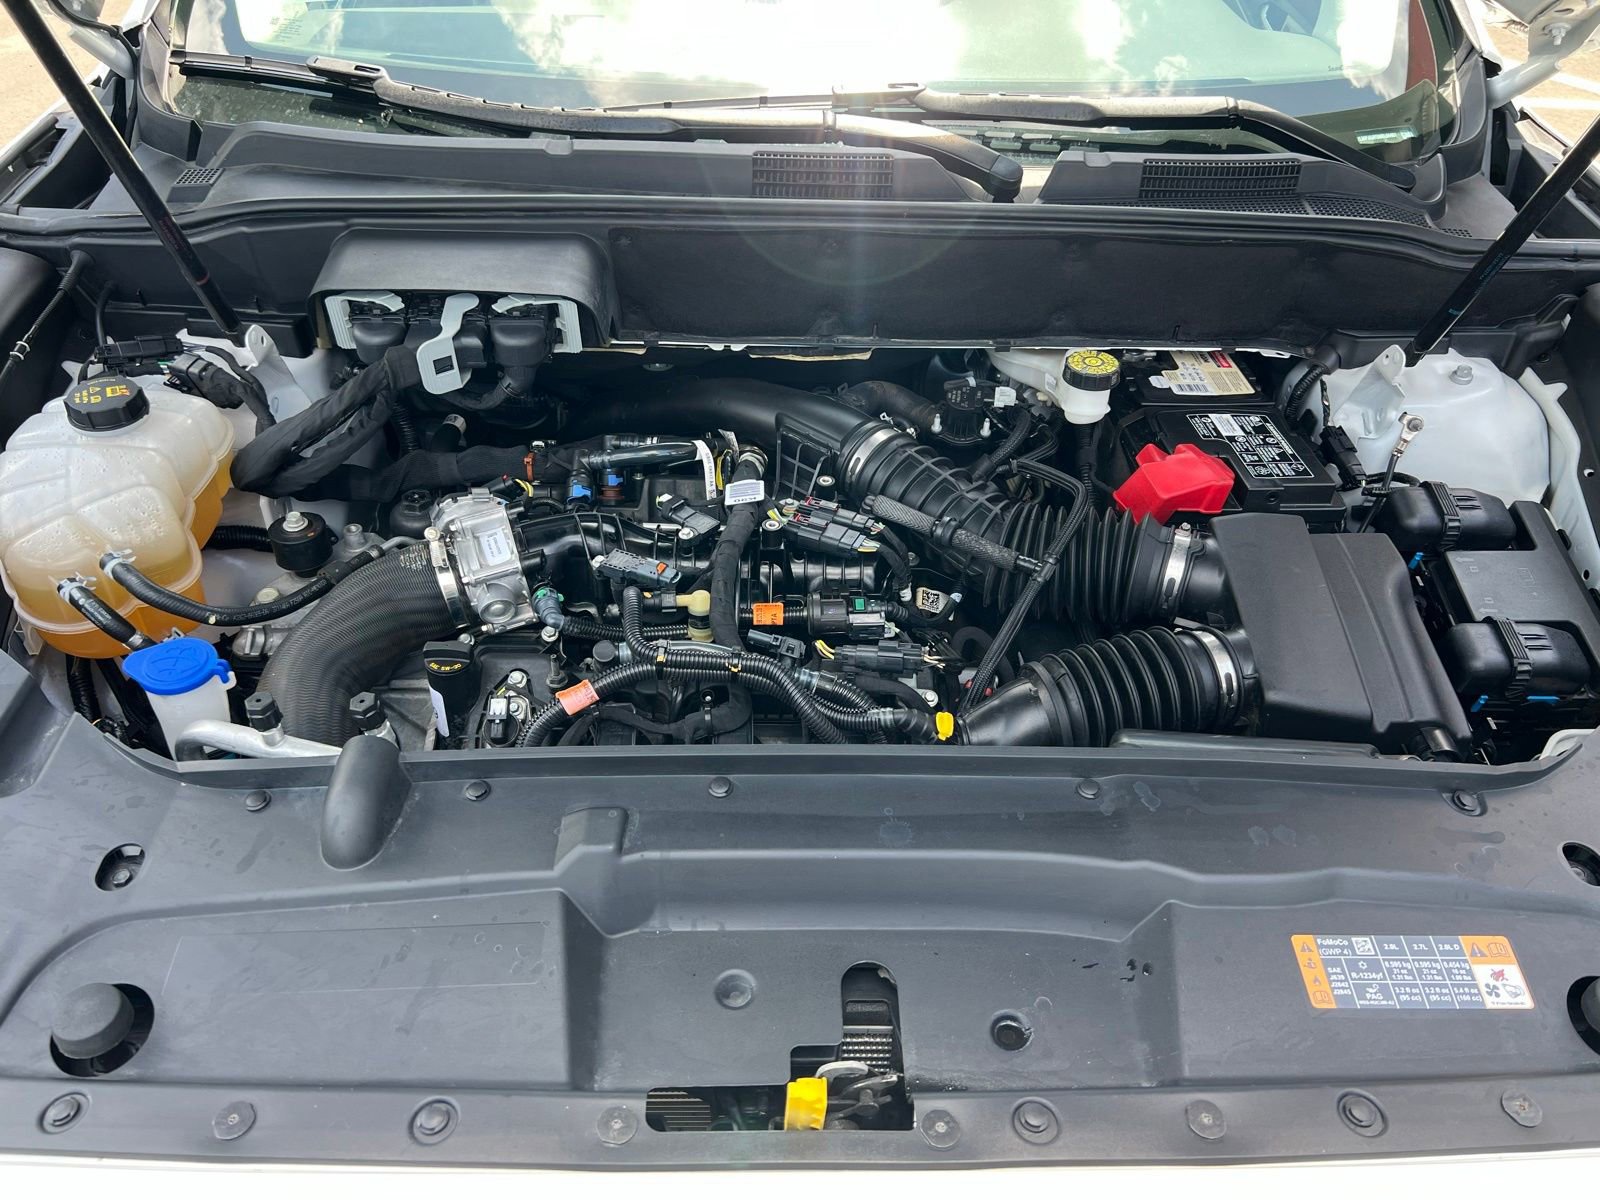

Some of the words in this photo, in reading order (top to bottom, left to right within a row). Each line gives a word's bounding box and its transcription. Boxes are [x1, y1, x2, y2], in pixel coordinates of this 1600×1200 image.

[1316, 938, 1349, 946] FoMoCo
[1412, 943, 1429, 951] 2.7L
[1319, 948, 1342, 956] (GWP
[1343, 948, 1352, 956] 4)
[1403, 961, 1412, 970] kg
[1432, 961, 1441, 970] kg
[1460, 961, 1470, 970] kg
[1351, 972, 1384, 981] R-1234yf
